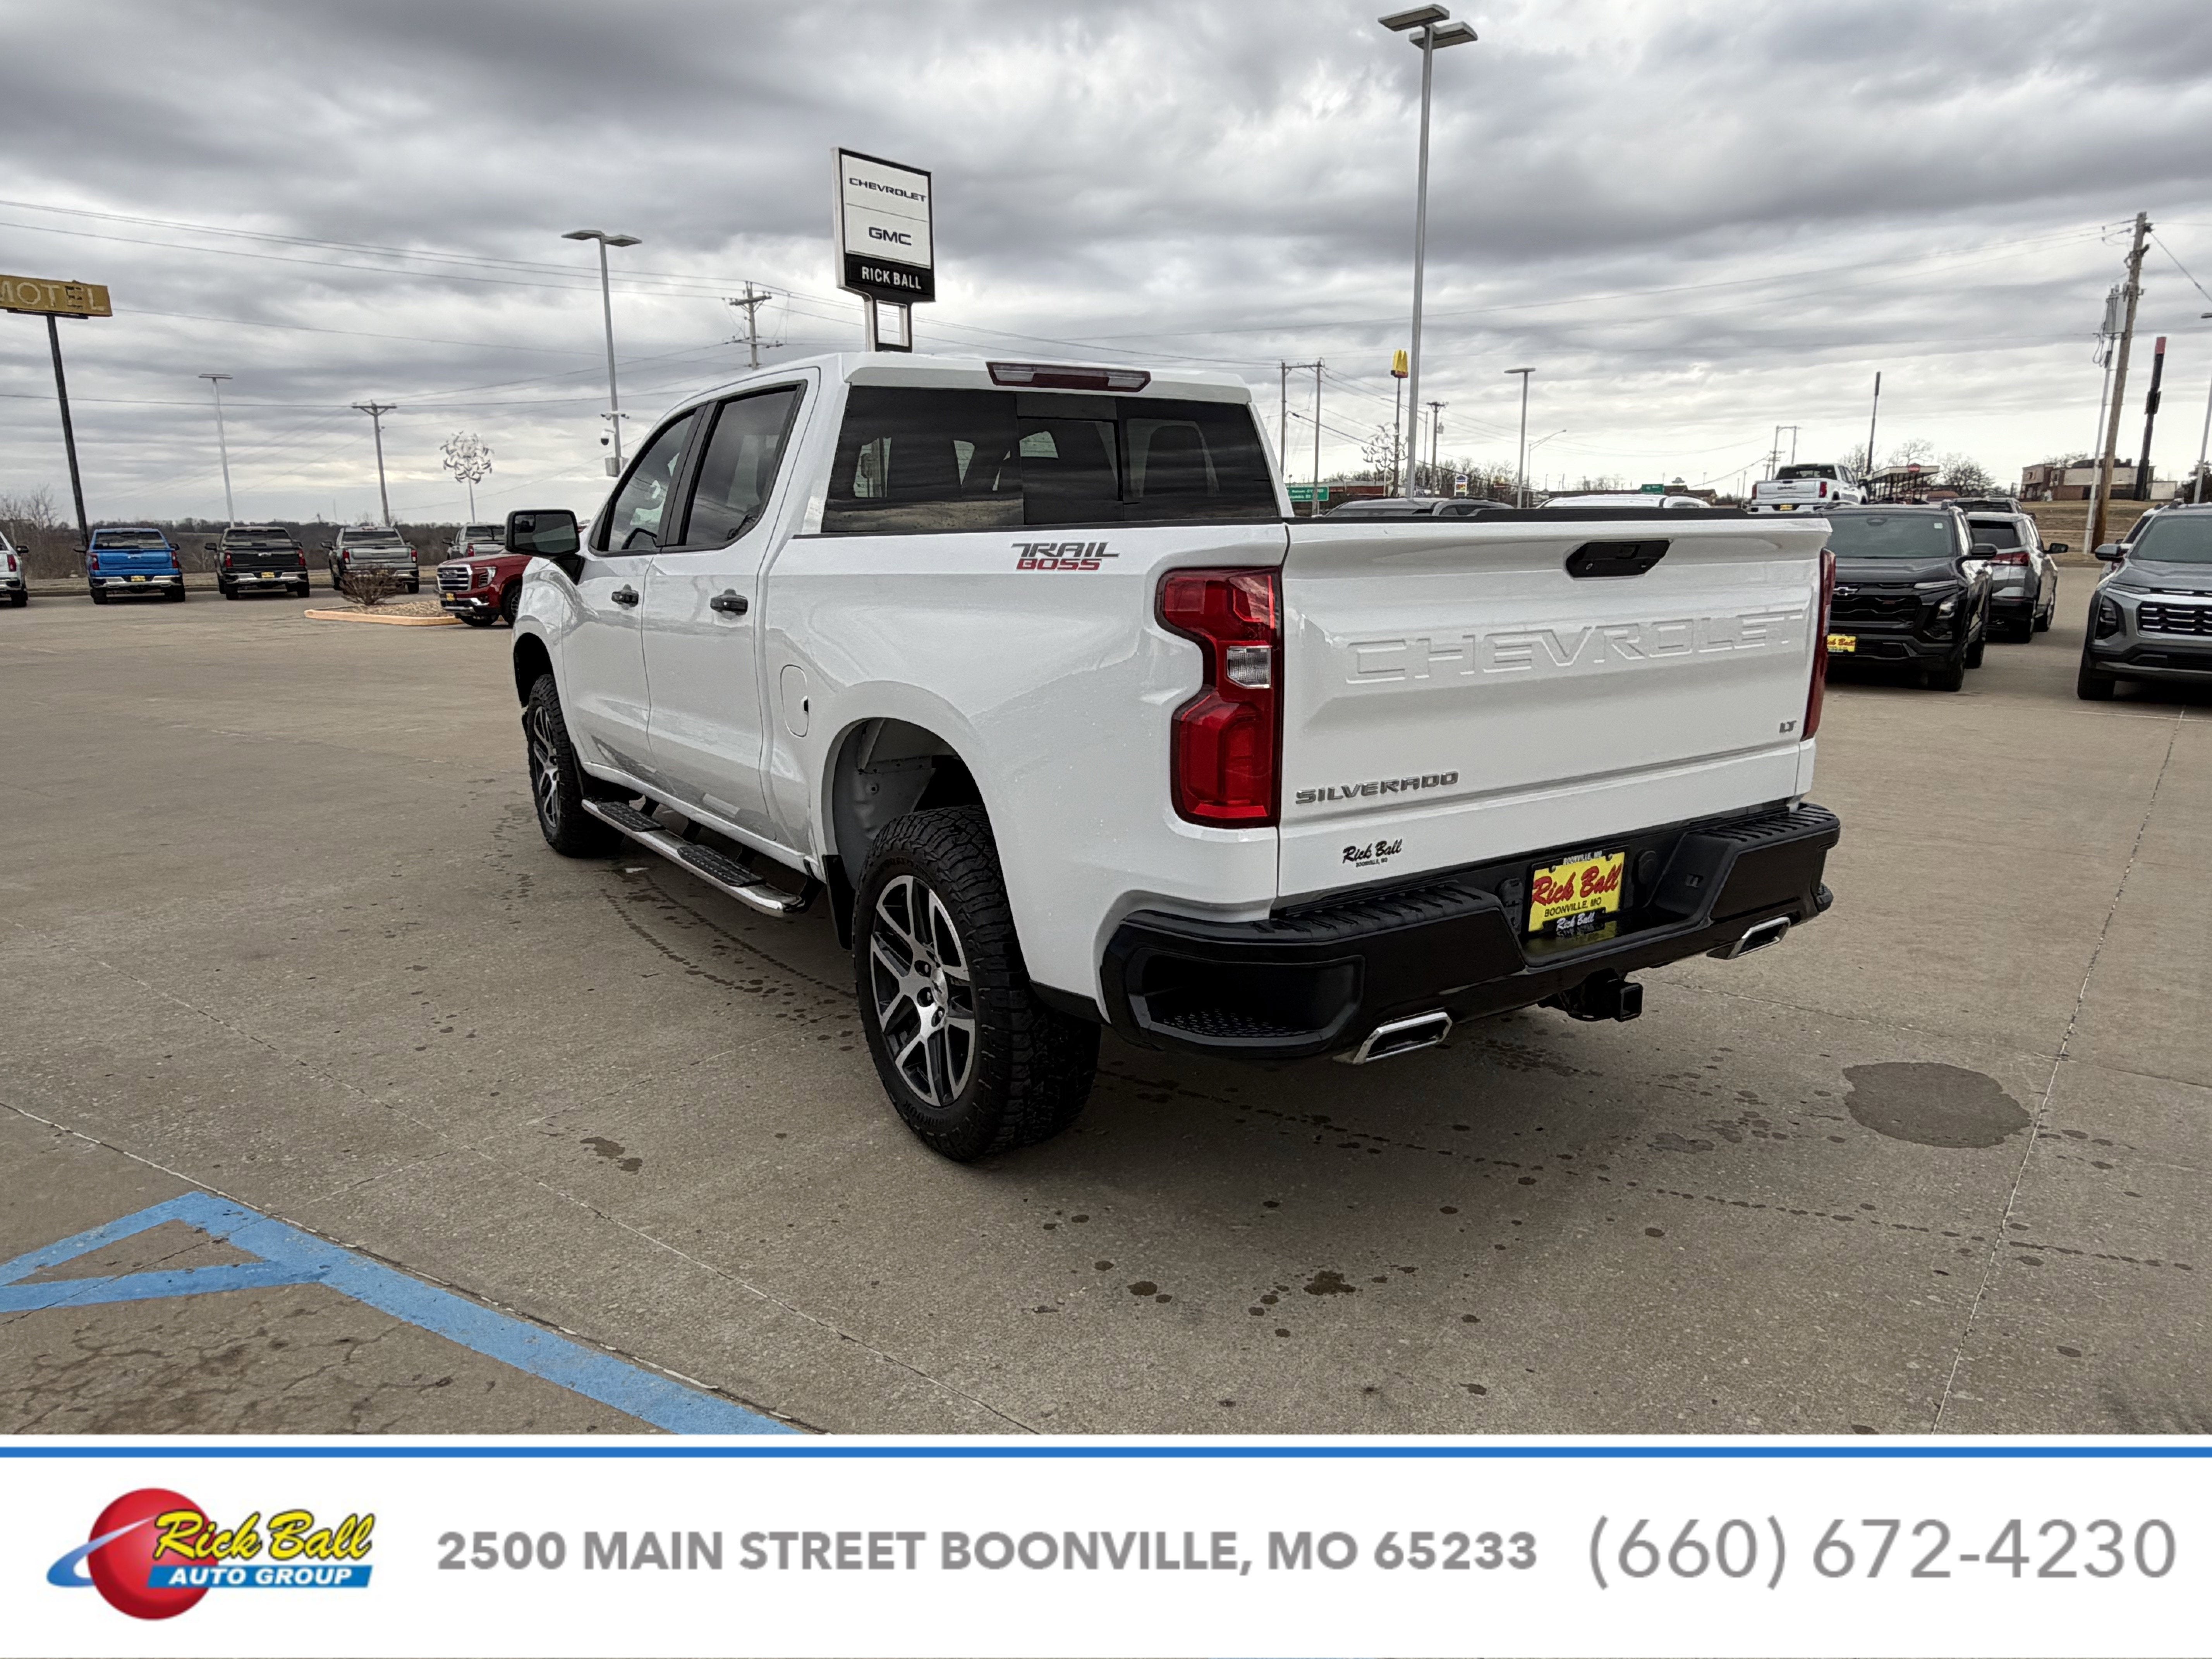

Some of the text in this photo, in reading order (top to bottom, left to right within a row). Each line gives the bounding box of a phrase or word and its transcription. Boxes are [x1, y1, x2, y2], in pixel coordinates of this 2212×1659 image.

[849, 177, 926, 202] CHEVROLET
[869, 227, 912, 246] GMC
[862, 266, 922, 290] RICK BALL
[1011, 542, 1121, 558] TRAIL
[1016, 558, 1102, 570] BOSS
[1346, 609, 1803, 684] CHEVROLET
[1779, 720, 1797, 733] LT
[1296, 771, 1459, 804] SILVERADO
[1342, 838, 1403, 864] Rick Ball
[1532, 862, 1622, 907] Rick Ball
[1590, 897, 1601, 907] MO
[1577, 912, 1595, 925] Ball
